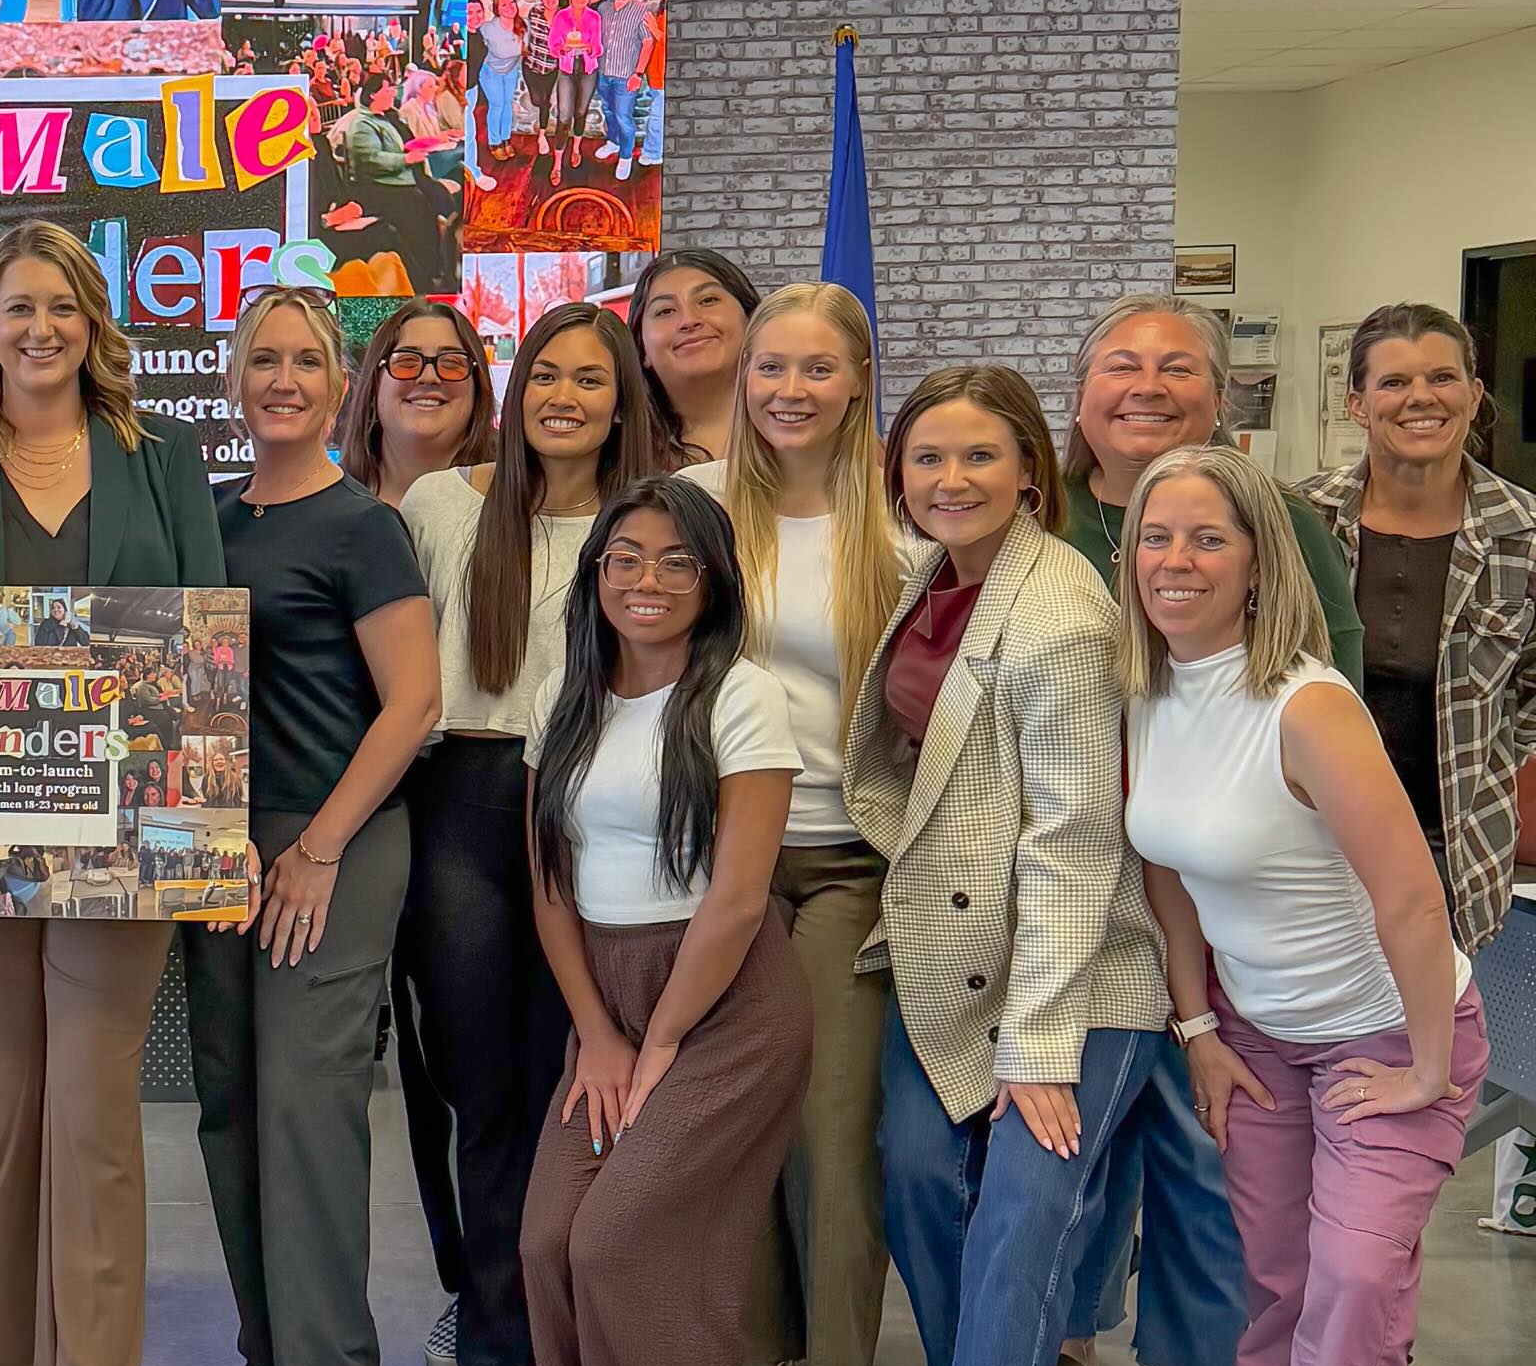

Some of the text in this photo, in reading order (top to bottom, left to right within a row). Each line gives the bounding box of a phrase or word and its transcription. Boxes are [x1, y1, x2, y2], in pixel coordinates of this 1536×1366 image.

[215, 438, 256, 462] old
[14, 782, 44, 797] long
[45, 784, 101, 797] program
[24, 800, 51, 810] 18-23
[52, 802, 80, 812] years
[82, 801, 99, 811] old
